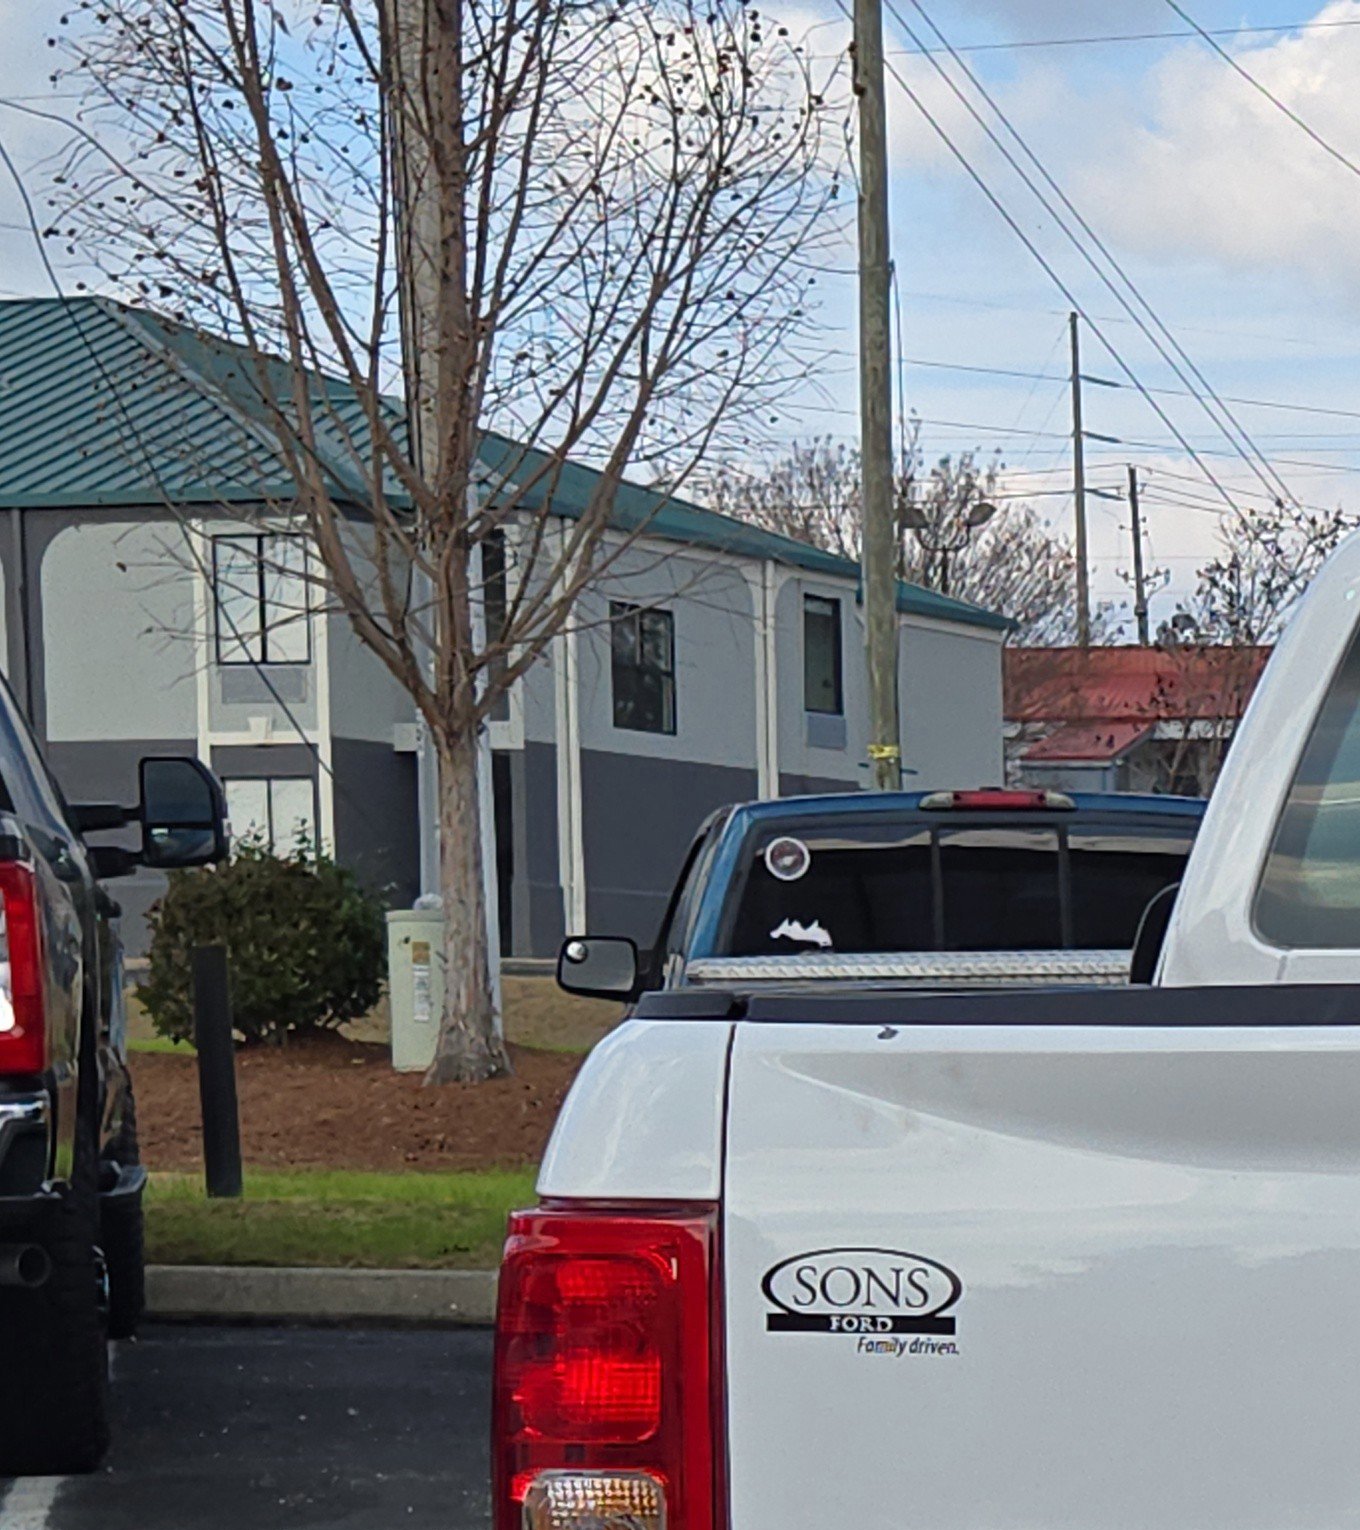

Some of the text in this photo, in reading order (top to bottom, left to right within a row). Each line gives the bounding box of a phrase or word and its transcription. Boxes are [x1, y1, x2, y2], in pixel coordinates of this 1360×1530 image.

[792, 1265, 930, 1308] SONS
[829, 1316, 894, 1333] FORD
[857, 1336, 960, 1358] Family driven.
